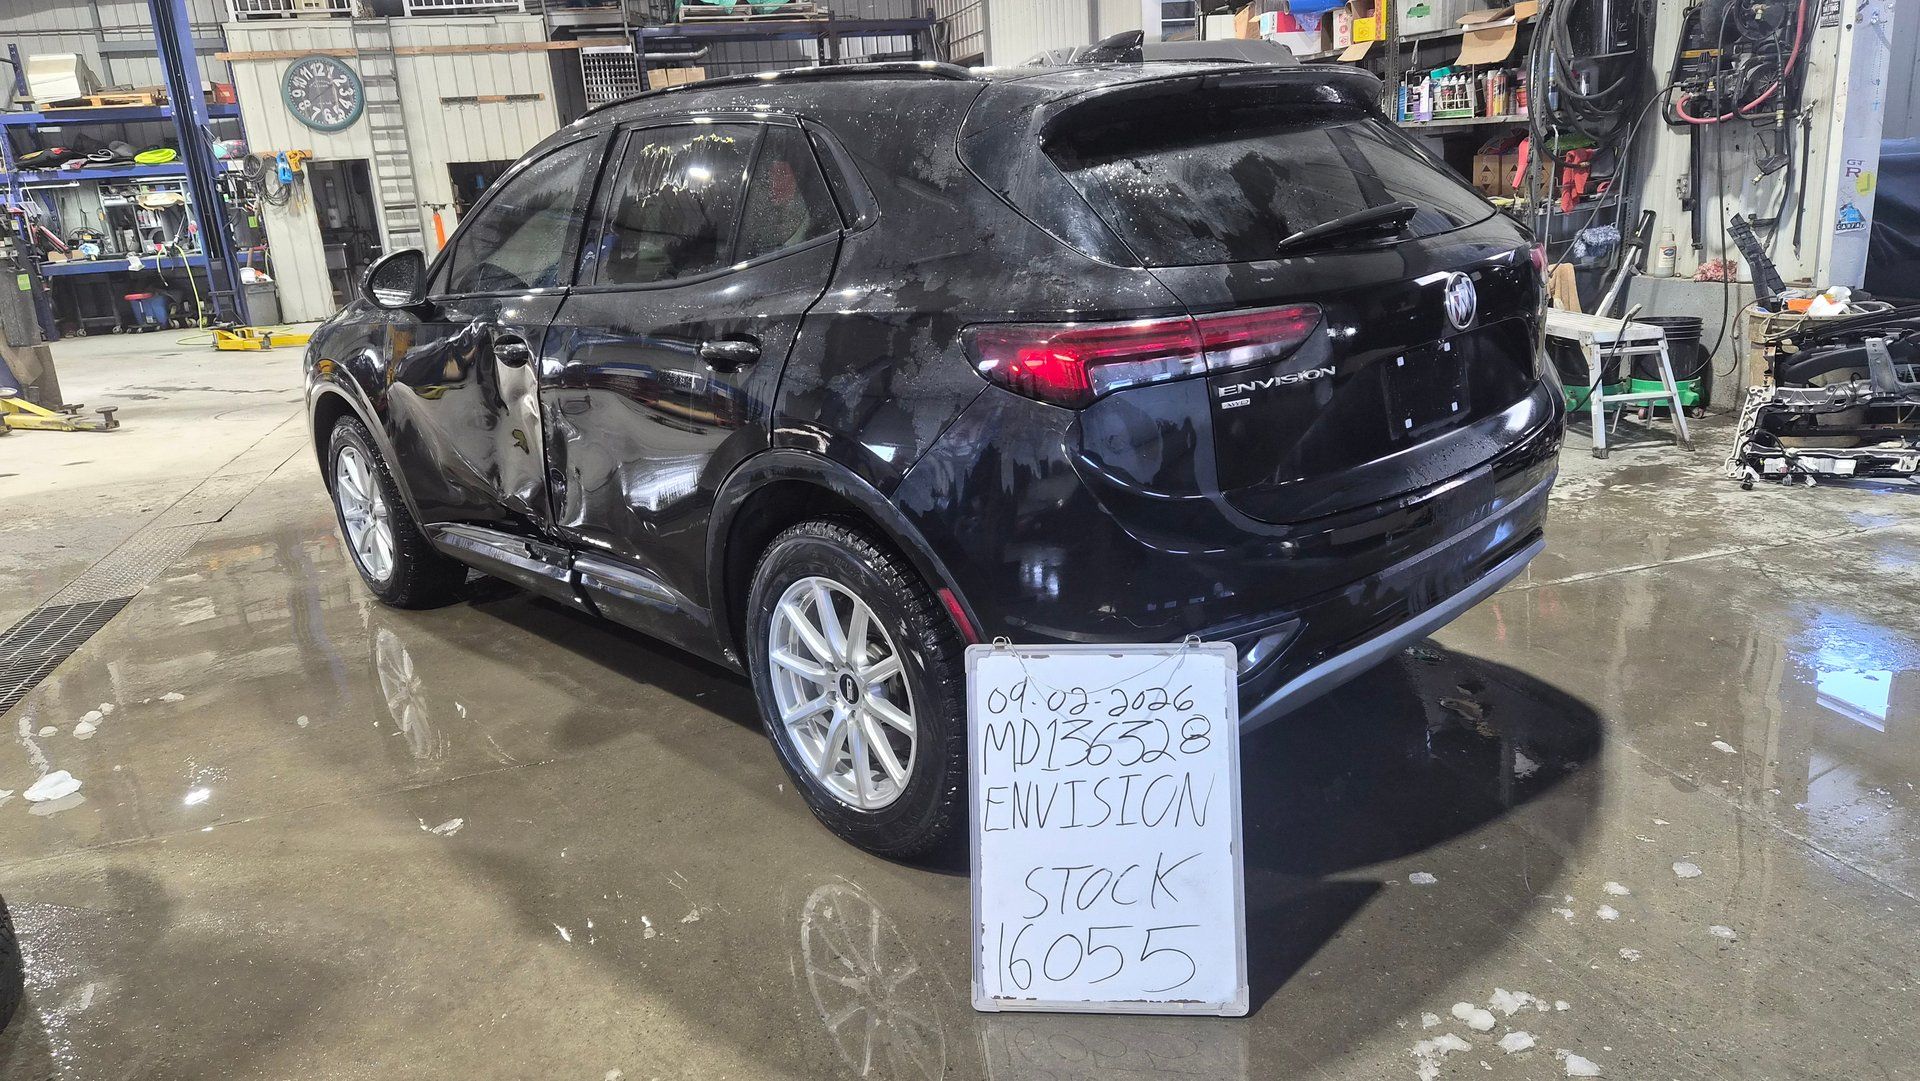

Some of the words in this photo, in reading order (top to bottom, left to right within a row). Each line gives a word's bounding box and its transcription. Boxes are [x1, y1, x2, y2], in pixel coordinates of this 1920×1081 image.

[299, 66, 313, 80] 11
[310, 62, 325, 77] 12
[292, 75, 307, 88] 10
[333, 74, 348, 87] 2
[291, 89, 306, 98] 9
[339, 87, 354, 97] 3
[298, 99, 312, 111] 8
[339, 98, 353, 110] 4
[311, 105, 322, 121] 7
[1845, 167, 1862, 178] R
[1218, 365, 1336, 398] ENVISION
[1222, 398, 1250, 409] AWD
[983, 714, 1212, 776] MD136328
[984, 772, 1216, 832] ENVISION
[1022, 852, 1204, 920] STOCK
[998, 922, 1201, 993] 16055
